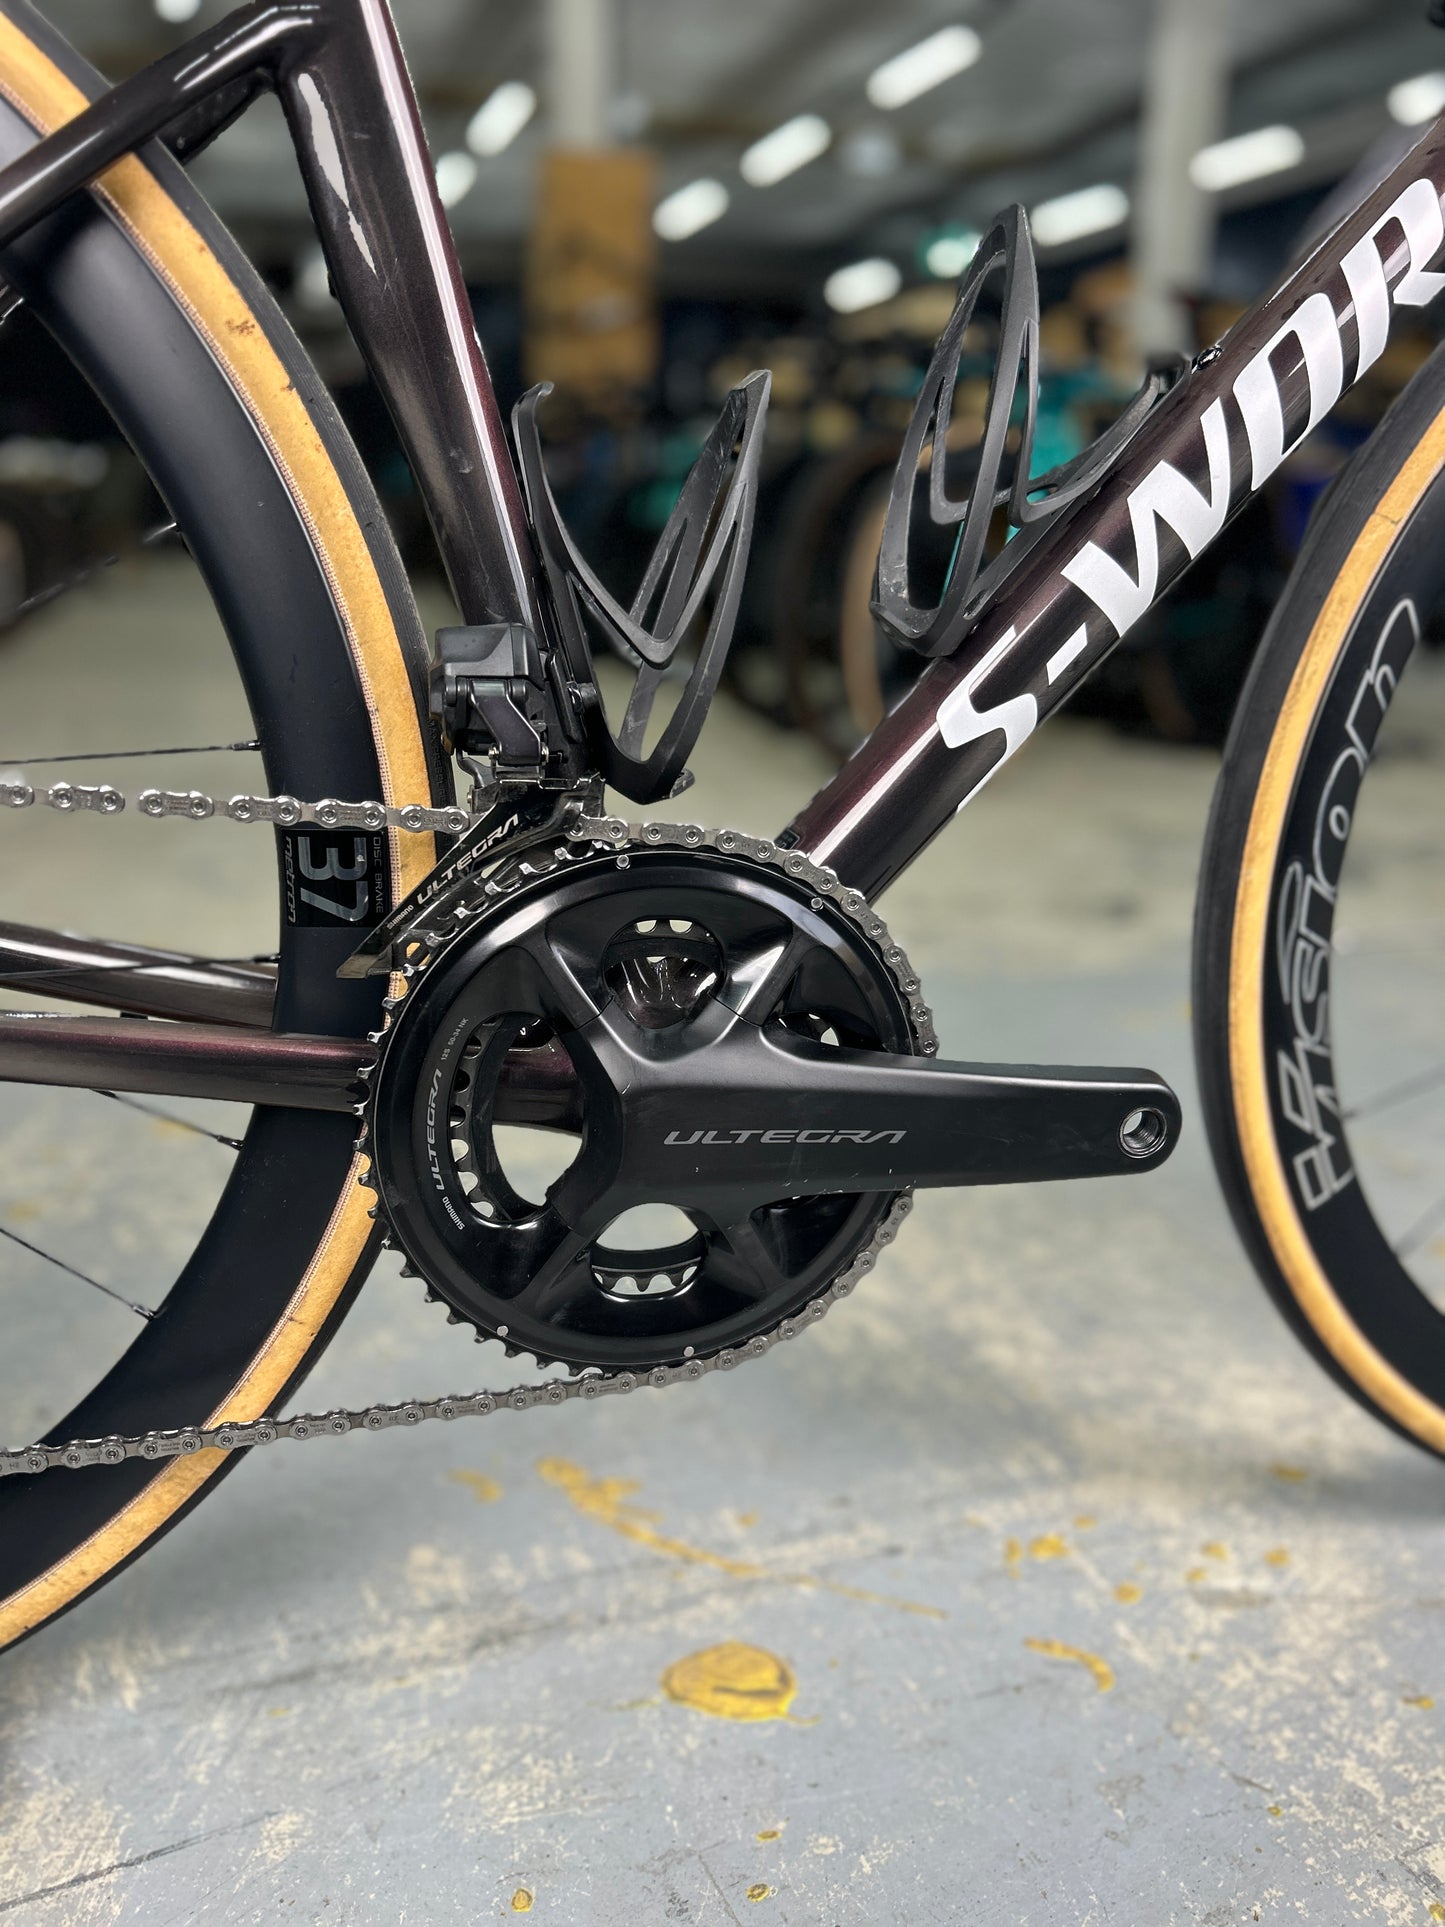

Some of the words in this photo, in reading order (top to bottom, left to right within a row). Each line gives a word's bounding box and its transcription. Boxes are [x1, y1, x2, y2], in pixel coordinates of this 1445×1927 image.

[373, 836, 382, 867] DISC
[386, 904, 414, 931] SHIMANO
[417, 813, 519, 905] ULTEGRA
[297, 836, 369, 922] 37
[374, 873, 384, 914] BRAKE
[426, 1068, 445, 1190] ULTEGRA
[663, 1130, 907, 1145] ULTEGRA
[442, 1196, 466, 1231] SHIMANO
